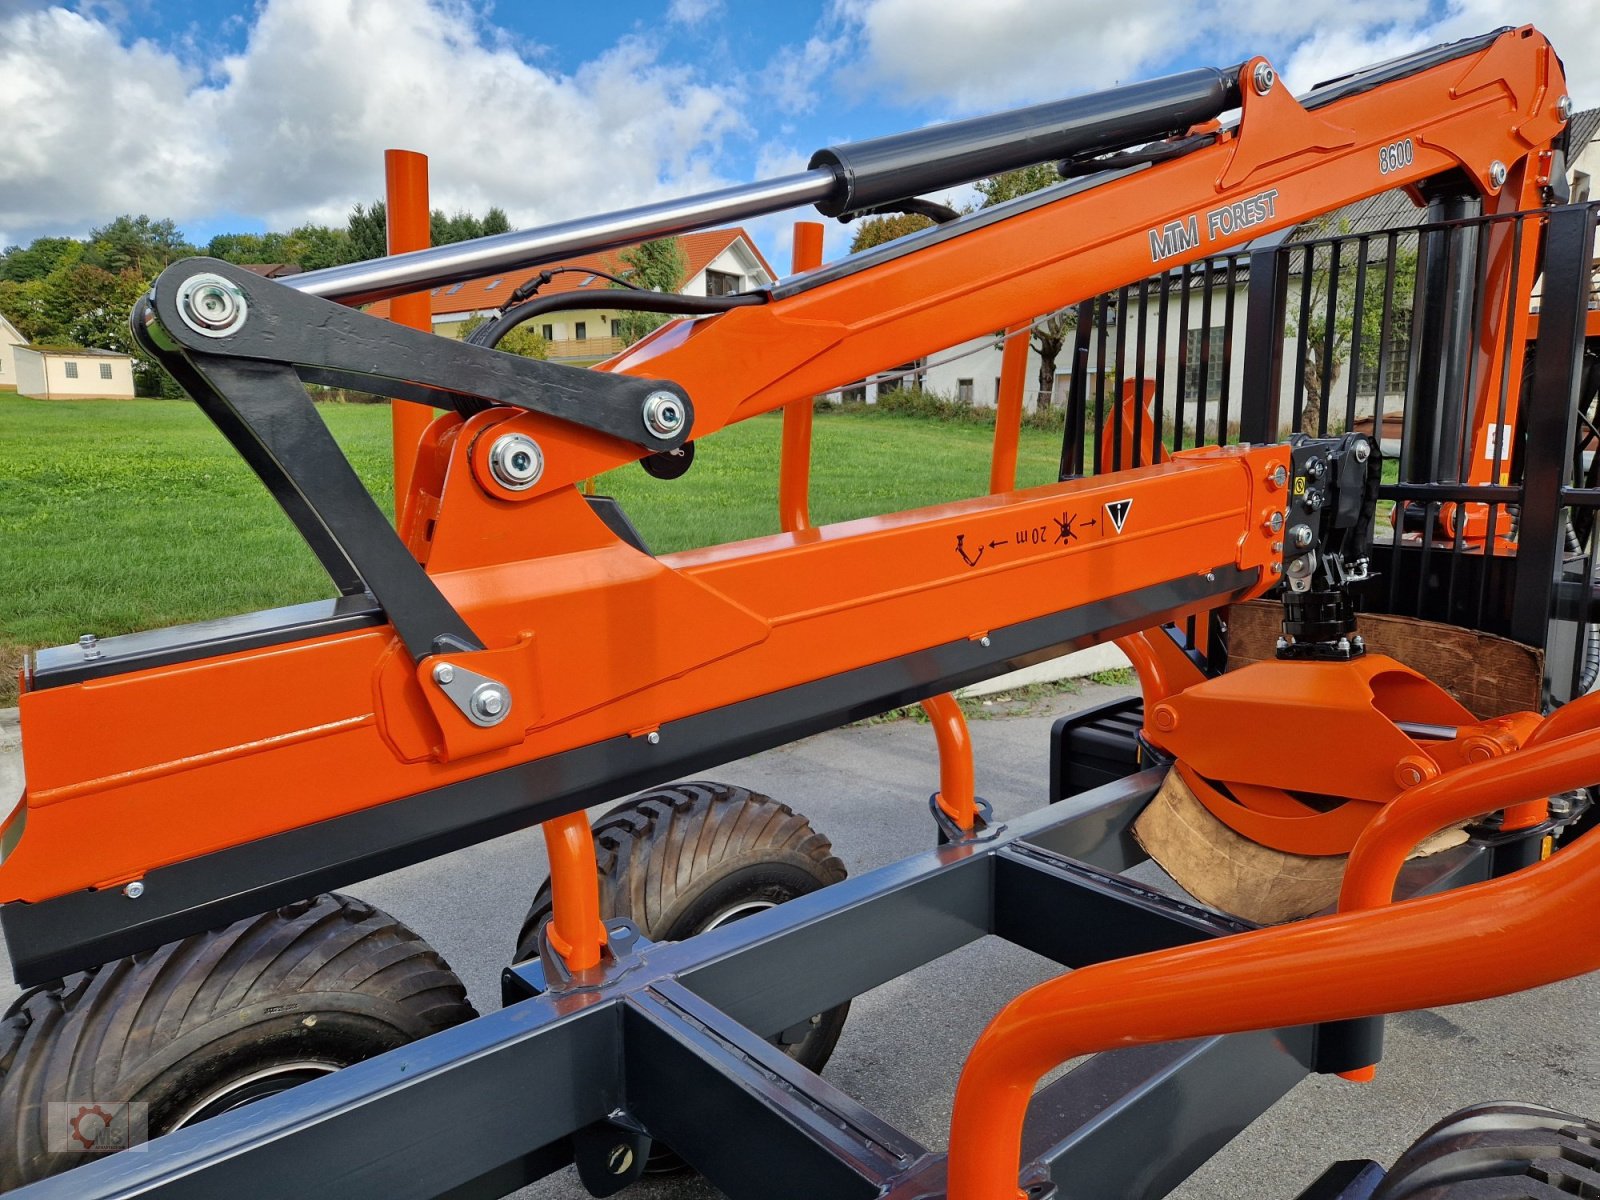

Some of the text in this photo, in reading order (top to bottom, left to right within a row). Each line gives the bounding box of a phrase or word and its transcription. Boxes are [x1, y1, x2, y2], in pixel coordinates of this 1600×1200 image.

[1379, 139, 1413, 175] 8600
[1149, 189, 1278, 262] MTM FOREST
[1015, 525, 1046, 544] 20 m
